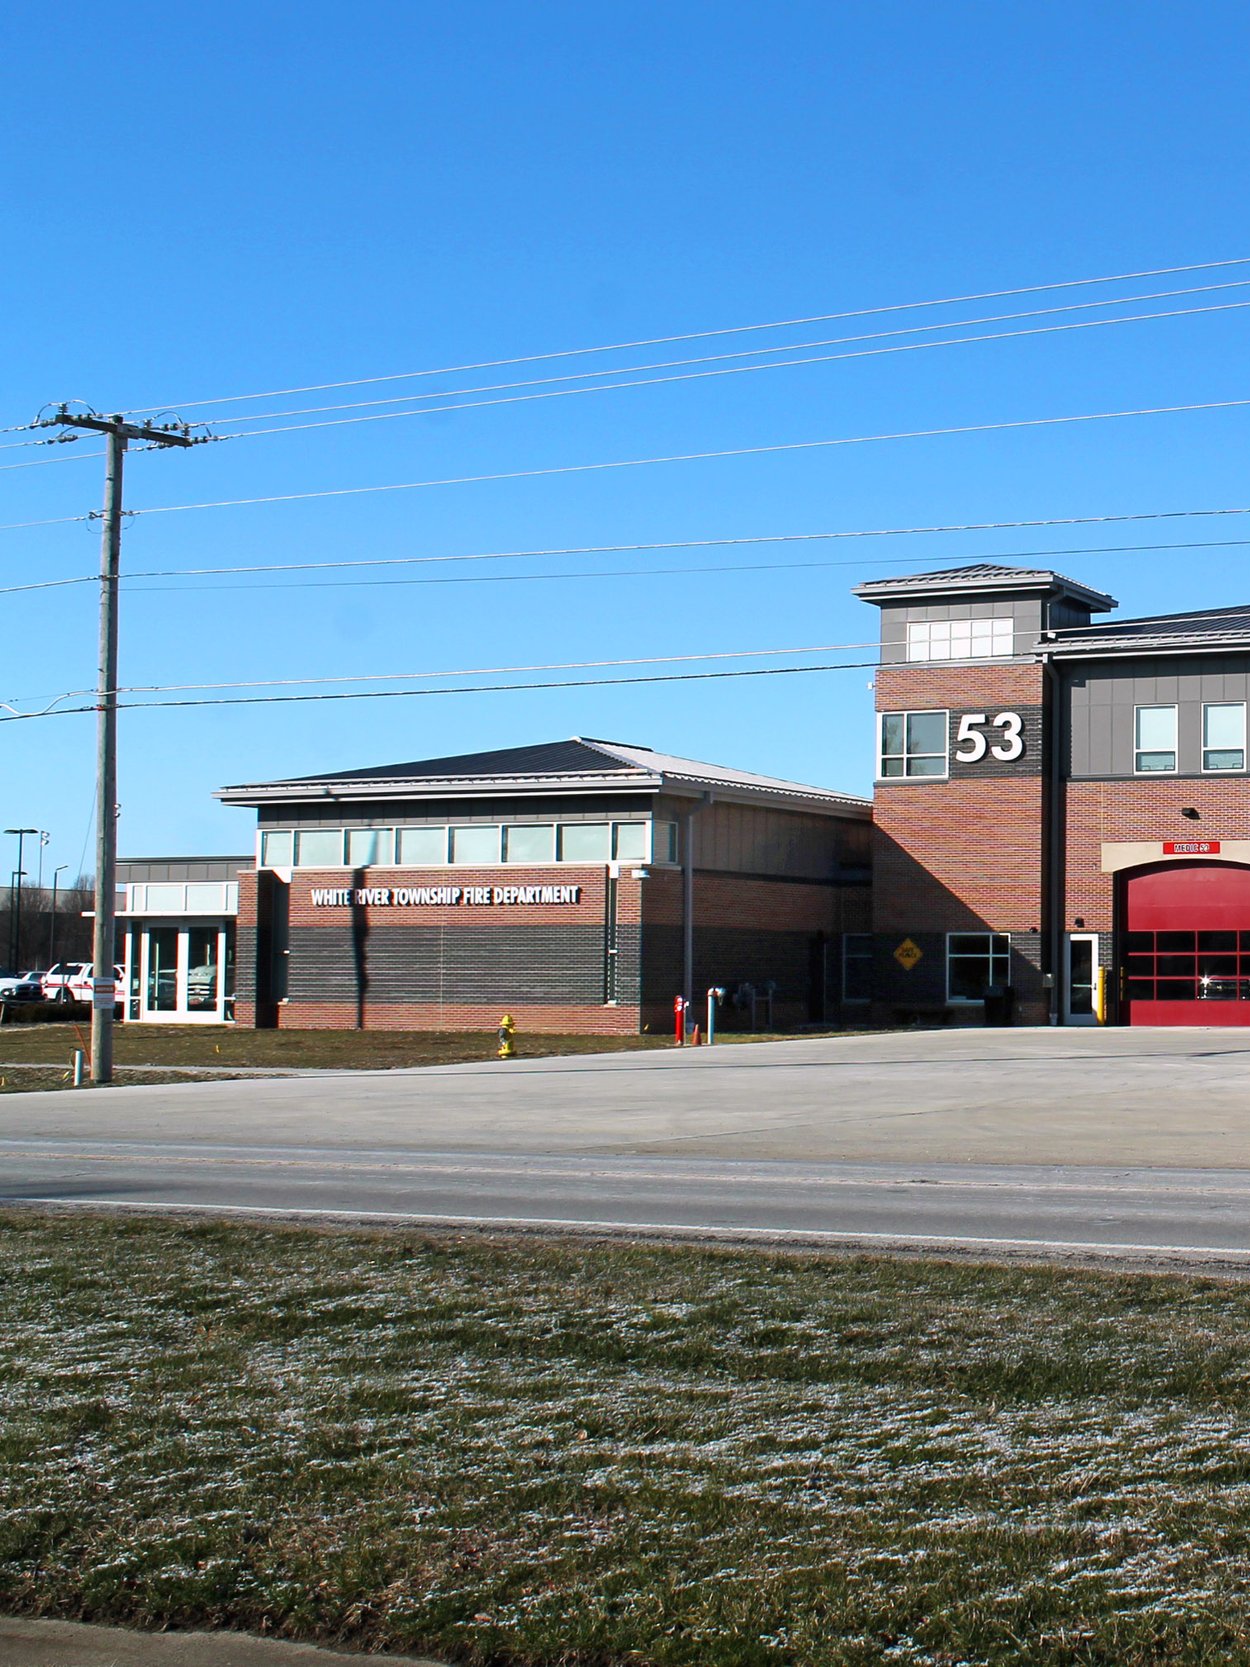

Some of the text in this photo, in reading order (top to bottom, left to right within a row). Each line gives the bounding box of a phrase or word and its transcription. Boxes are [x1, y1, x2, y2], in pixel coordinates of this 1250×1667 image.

[955, 711, 1023, 763] 53
[1174, 843, 1199, 853] MEDIC
[311, 885, 579, 906] WHITE RIVER TOWNSHIP FIRE DEPARTMENT
